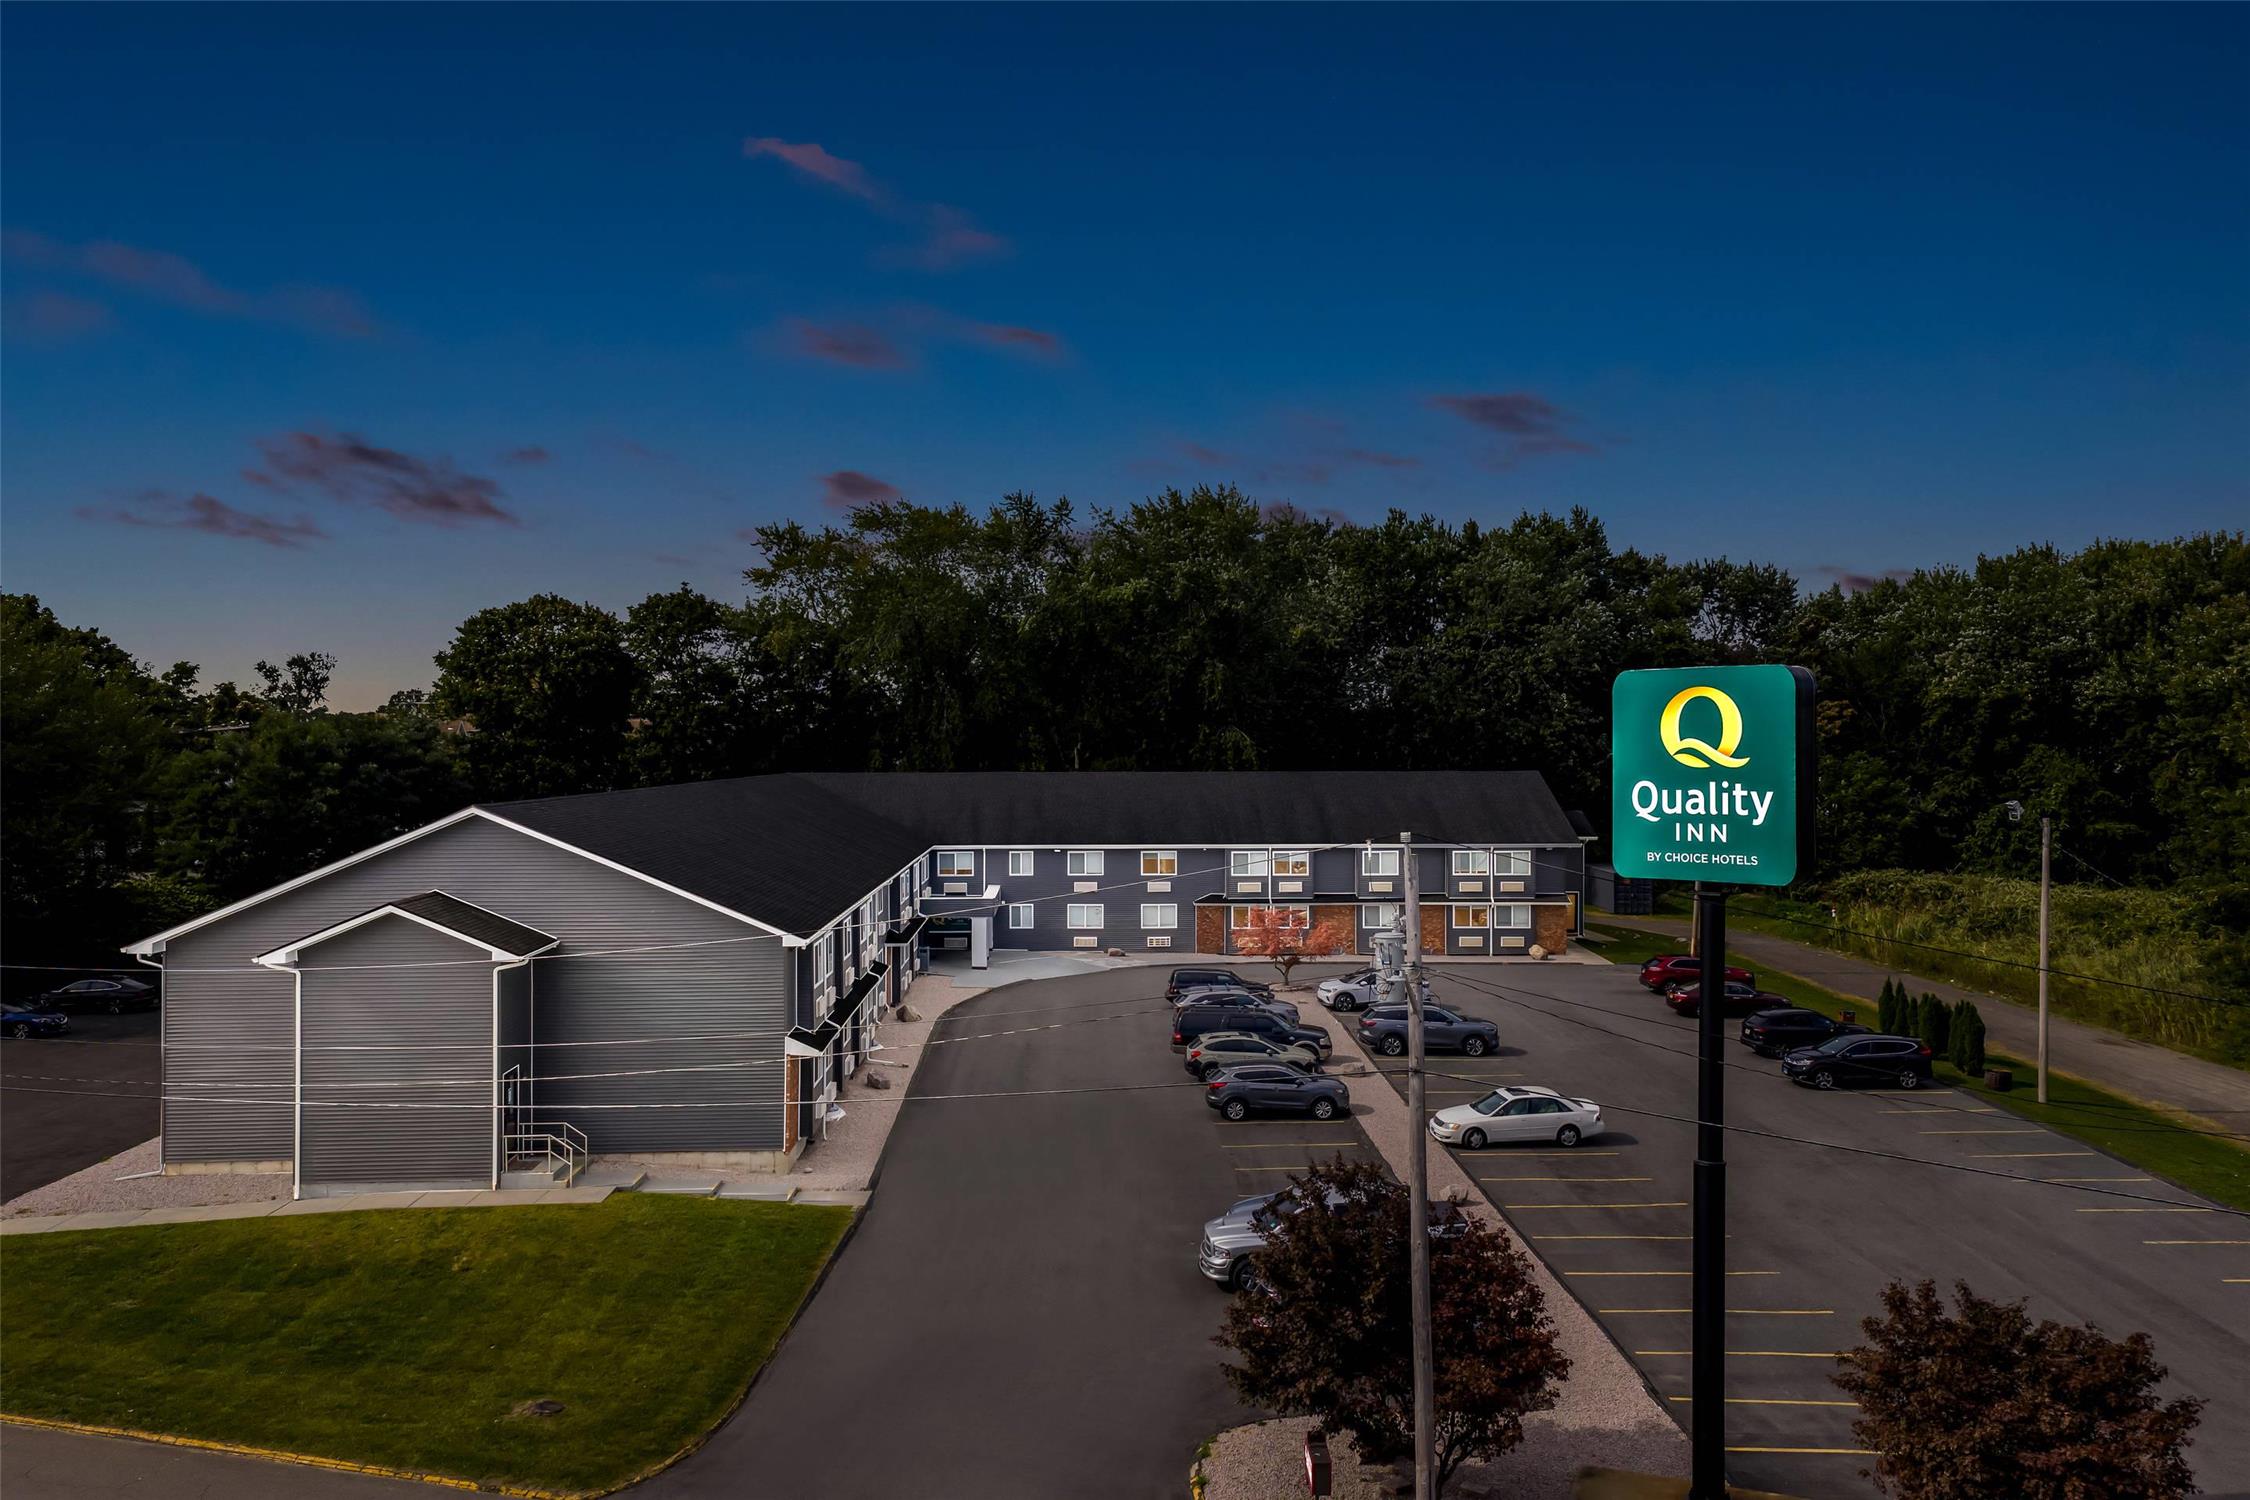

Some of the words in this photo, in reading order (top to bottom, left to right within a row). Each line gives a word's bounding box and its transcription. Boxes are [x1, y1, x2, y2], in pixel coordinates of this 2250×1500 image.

[1659, 686, 1751, 769] Q
[1631, 780, 1774, 826] Quality
[1675, 822, 1728, 843] INN
[1647, 851, 1661, 862] BY
[1665, 852, 1708, 864] CHOICE
[1711, 854, 1759, 866] HOTELS
